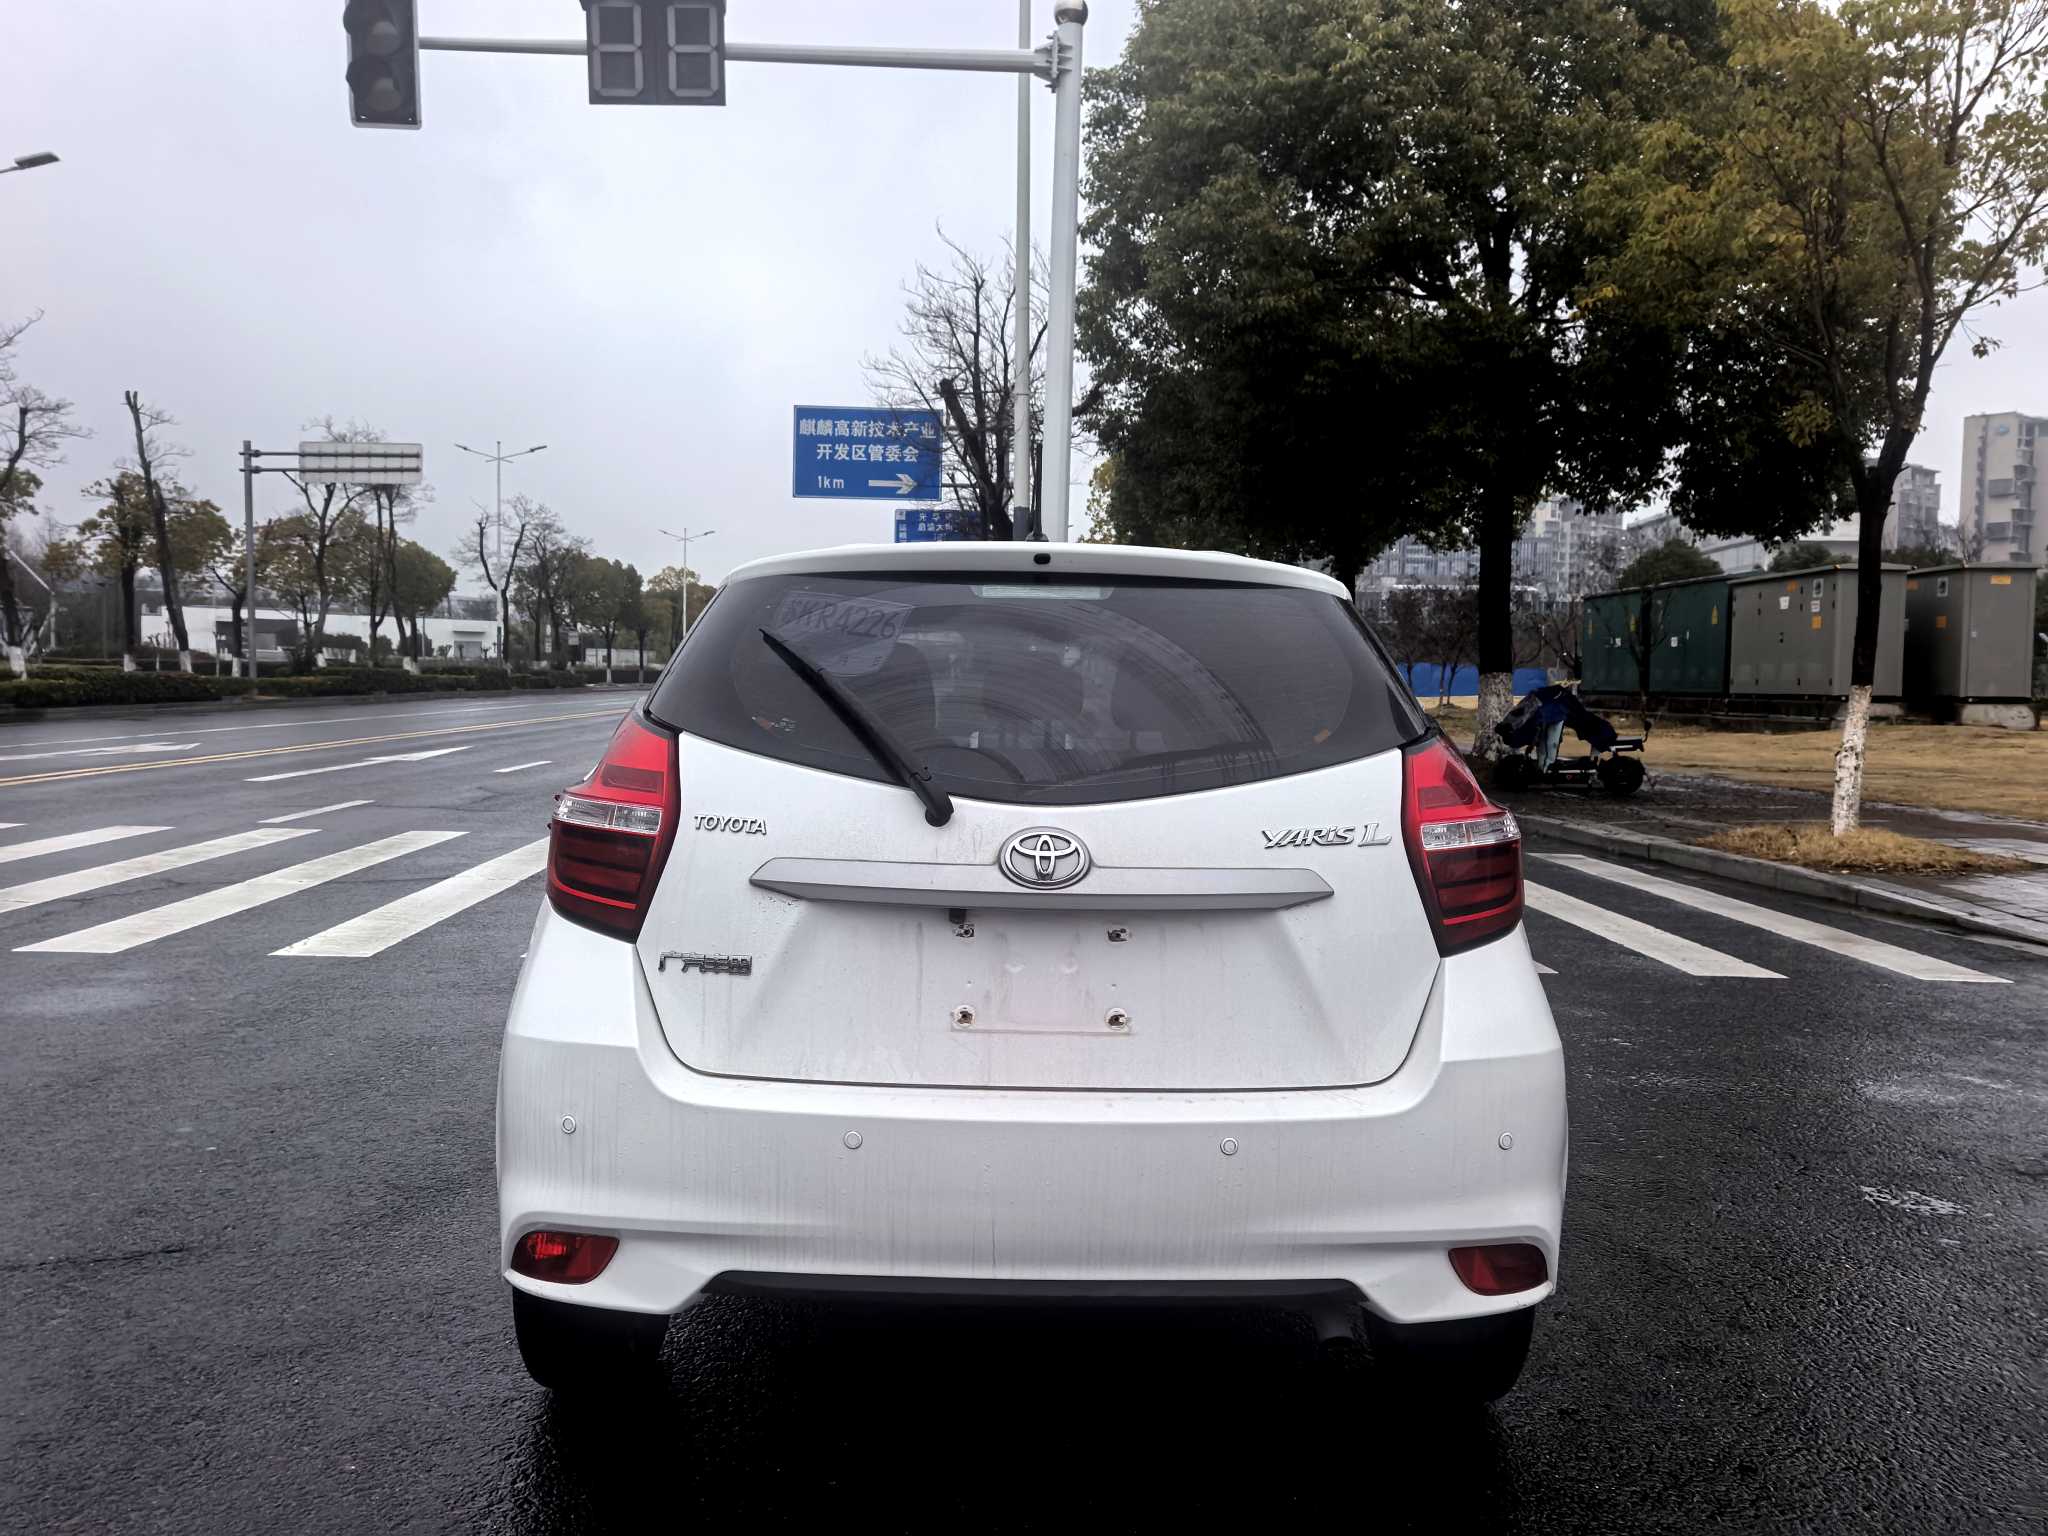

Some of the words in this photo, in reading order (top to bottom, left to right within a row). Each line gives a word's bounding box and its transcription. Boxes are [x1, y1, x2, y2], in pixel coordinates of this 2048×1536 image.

[816, 443, 919, 463] 开发区管委会
[817, 475, 844, 489] 1km
[694, 815, 767, 835] TOYOTA
[1357, 822, 1392, 847] L
